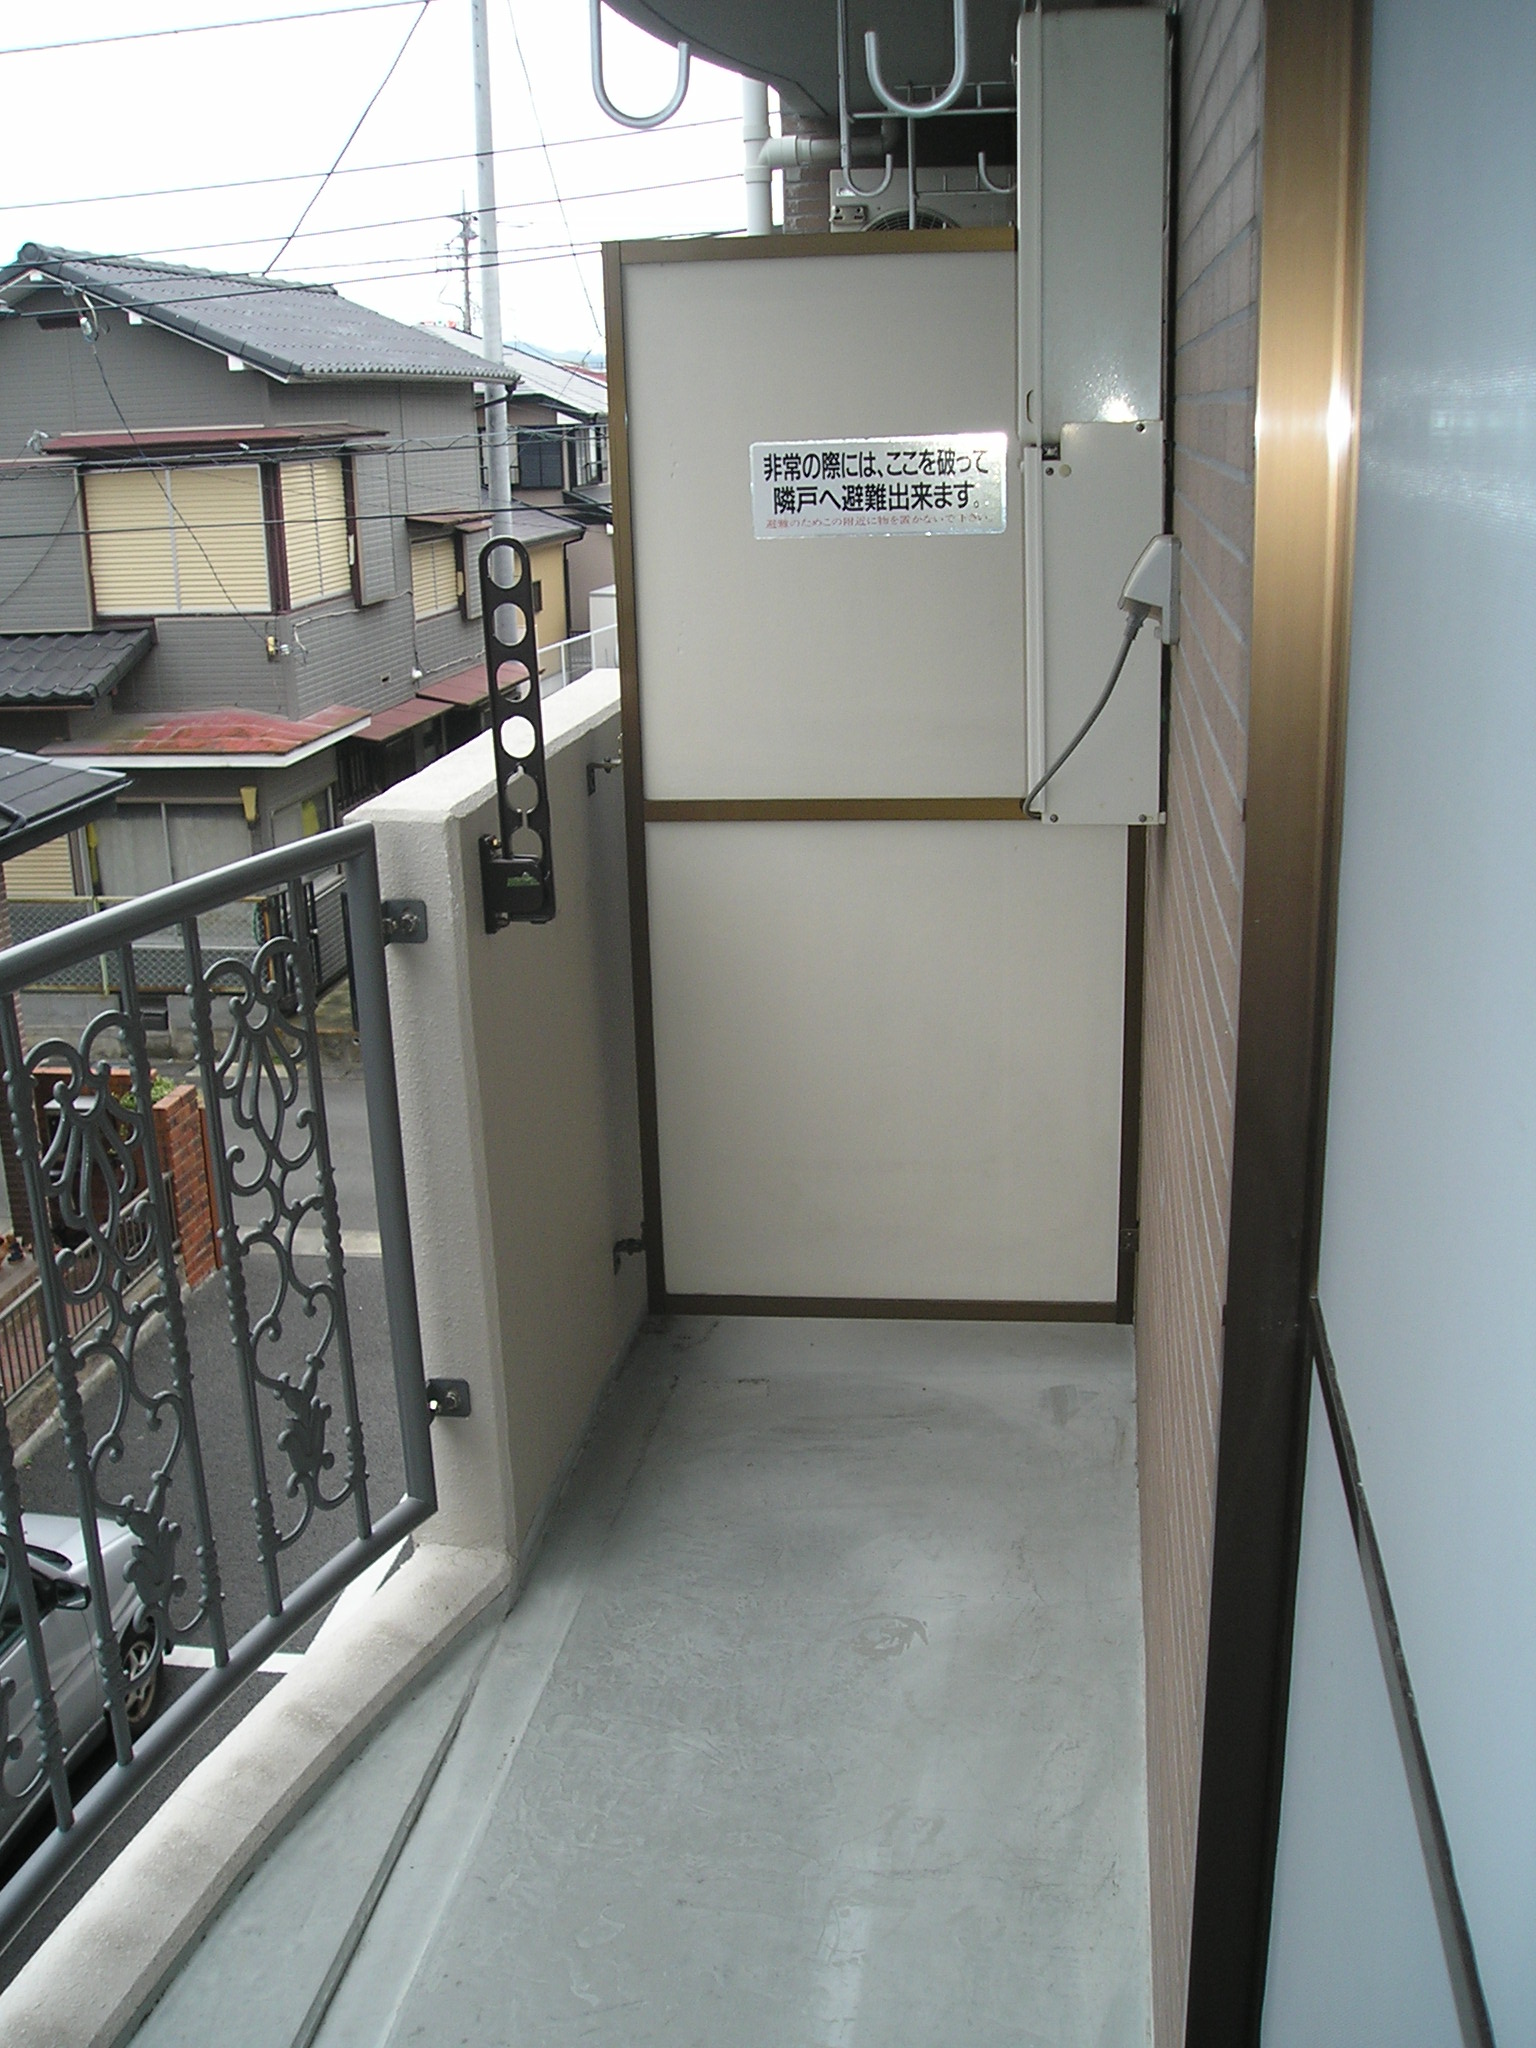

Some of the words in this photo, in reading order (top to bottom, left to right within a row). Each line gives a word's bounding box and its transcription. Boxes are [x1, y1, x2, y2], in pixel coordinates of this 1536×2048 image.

[763, 448, 988, 481] 非常の際には、ここを破って
[773, 480, 980, 514] 隣戸へ避難出来ます。
